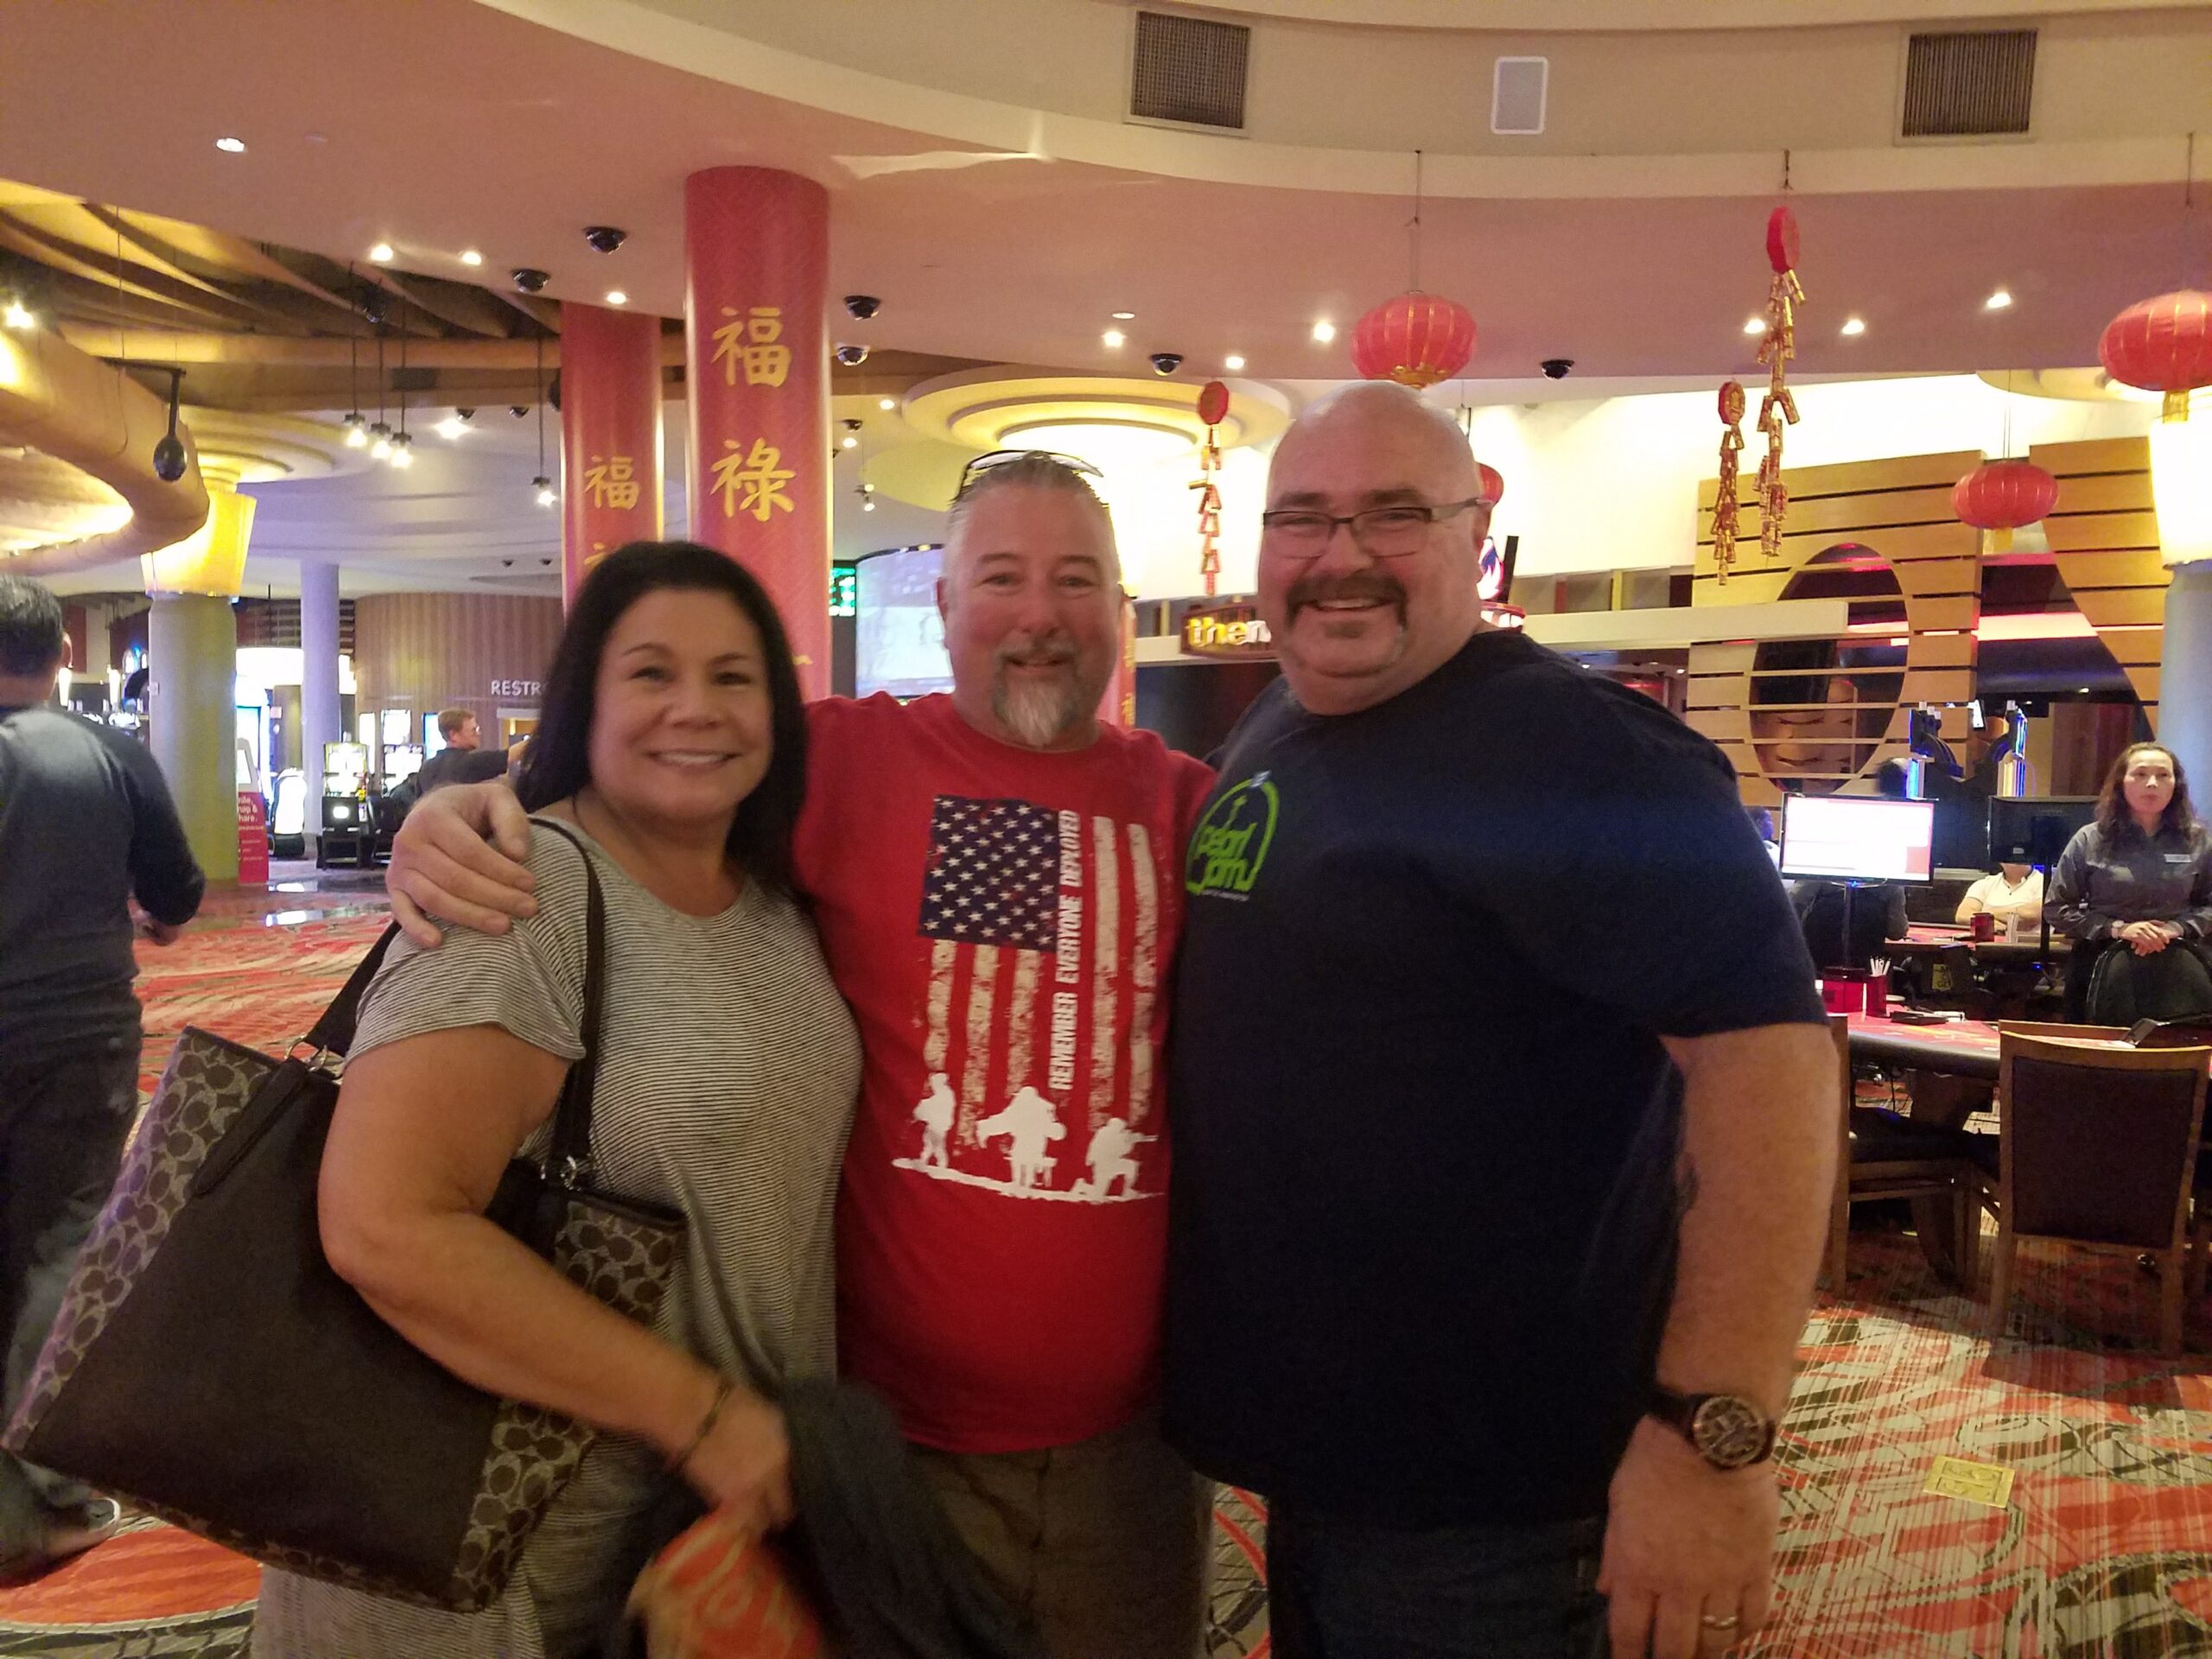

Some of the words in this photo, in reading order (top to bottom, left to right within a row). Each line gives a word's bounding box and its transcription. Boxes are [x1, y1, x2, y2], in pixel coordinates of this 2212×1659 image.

[491, 679, 549, 696] RESTR
[1058, 810, 1083, 887] DEPLOYED
[1055, 894, 1084, 983] EVERYONE
[1048, 992, 1078, 1090] REMEMBER
